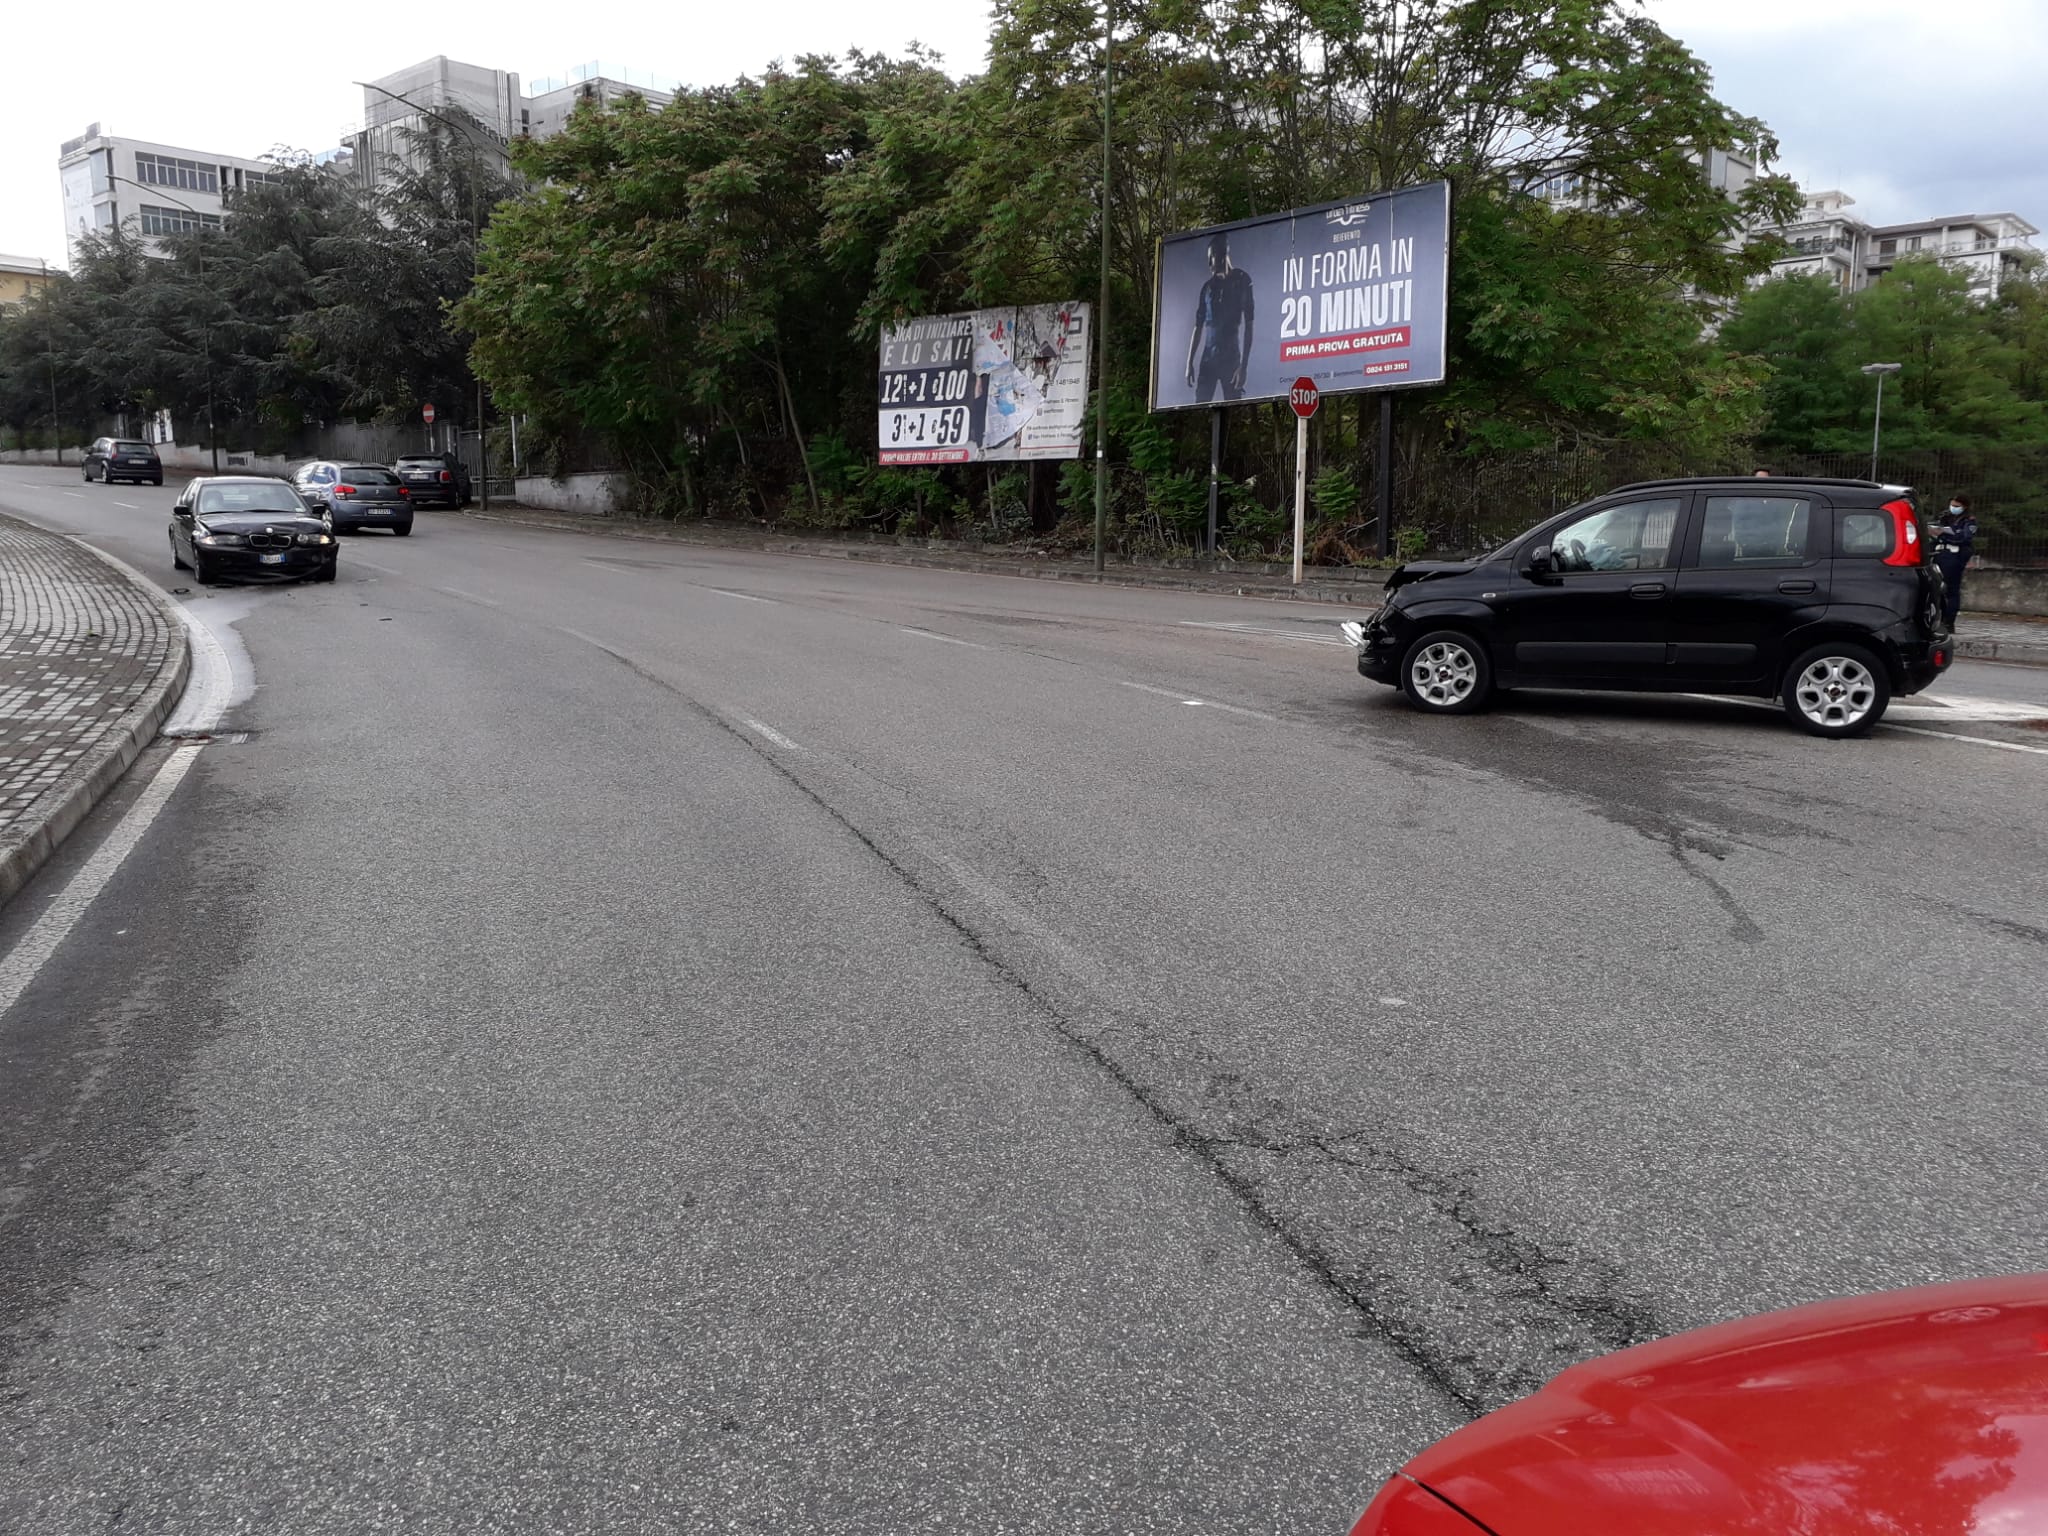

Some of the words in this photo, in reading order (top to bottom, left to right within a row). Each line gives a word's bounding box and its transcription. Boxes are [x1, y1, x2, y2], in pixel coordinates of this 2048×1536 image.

[1282, 257, 1304, 293] IN
[1311, 243, 1382, 288] FORMA
[1390, 237, 1413, 274] IN
[1280, 294, 1312, 338] 20
[1319, 278, 1413, 334] MINUTI
[913, 324, 925, 341] DI
[1285, 341, 1316, 357] PRIMA
[1318, 337, 1351, 353] PROVA
[1352, 332, 1404, 349] GRATUITA
[883, 345, 895, 367] E
[901, 342, 922, 365] LO
[930, 337, 972, 362] SAI!
[1292, 388, 1317, 405] STOP
